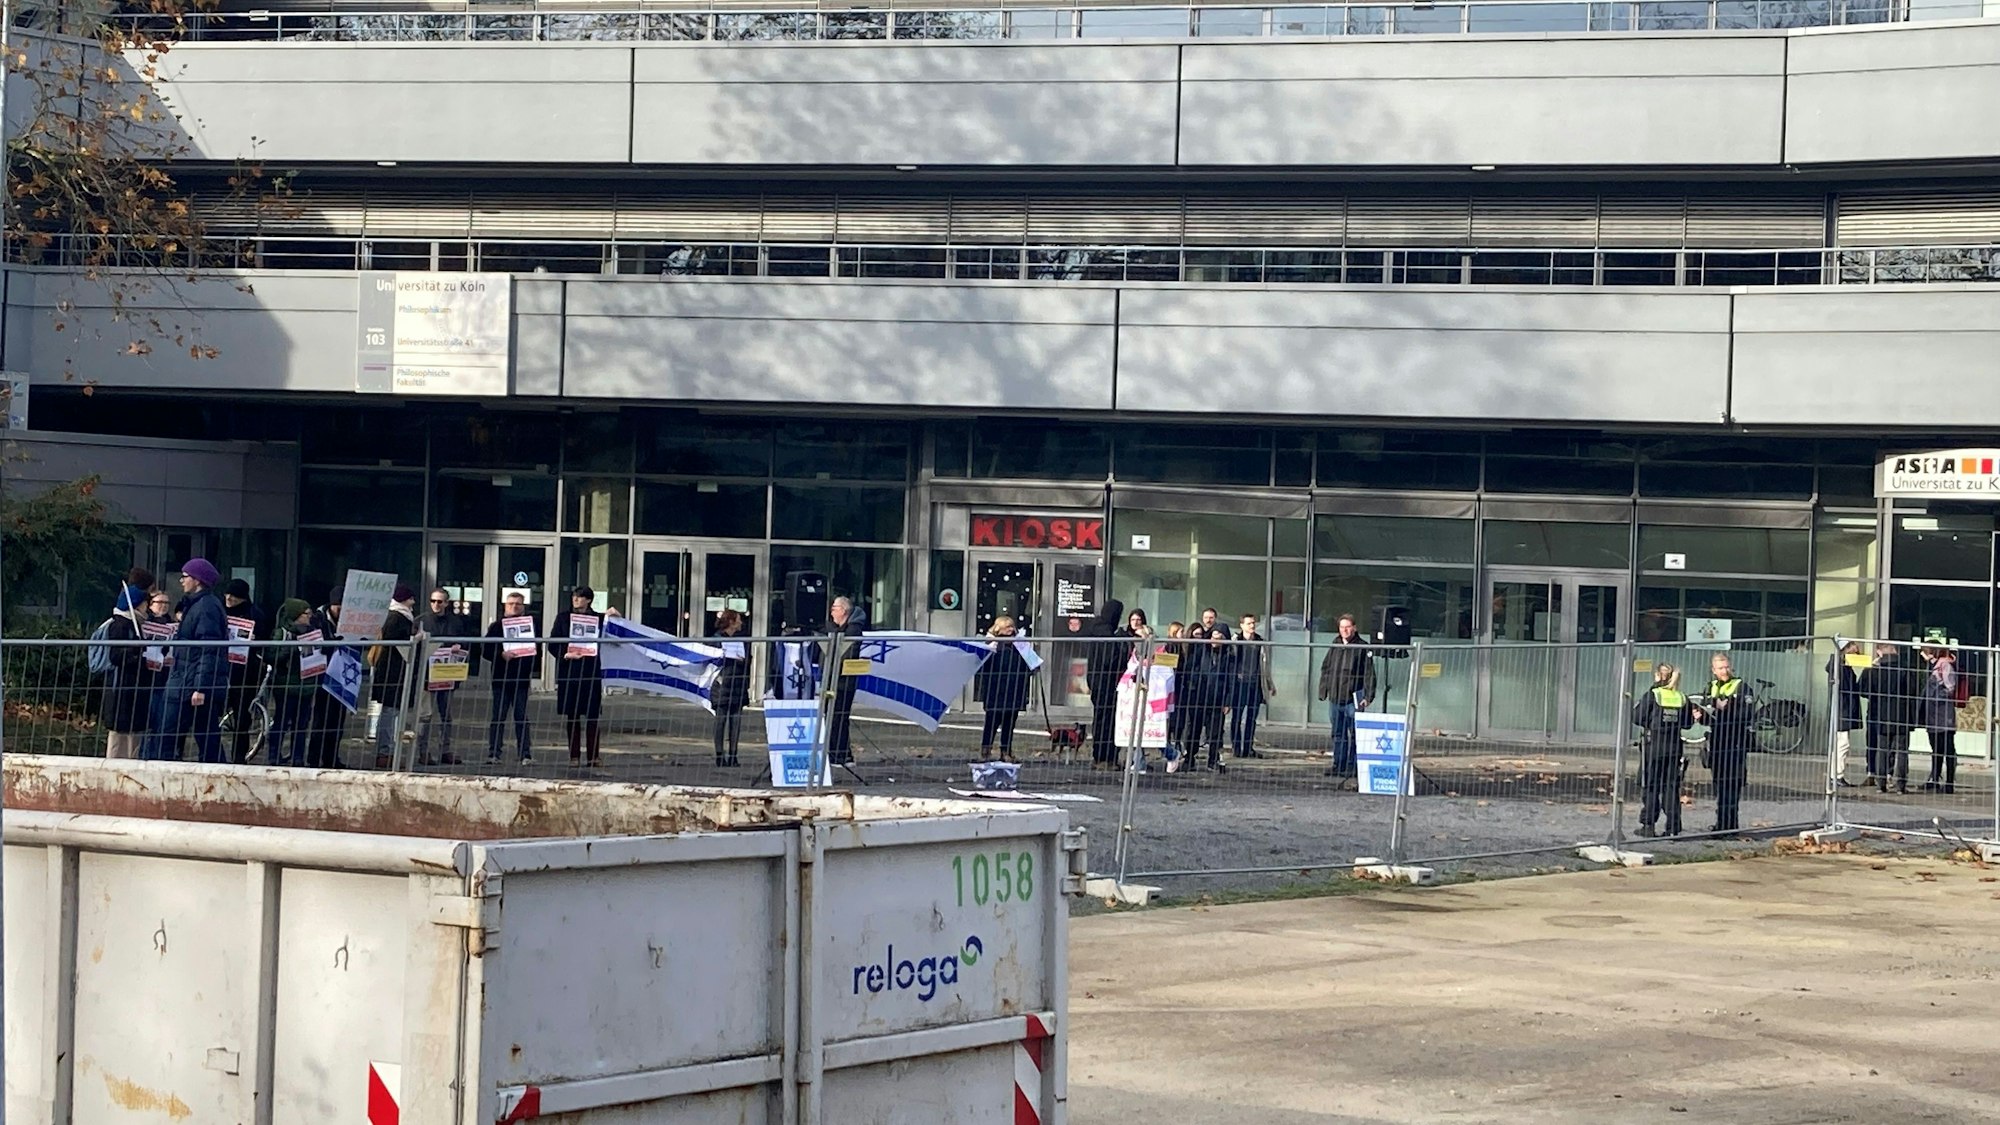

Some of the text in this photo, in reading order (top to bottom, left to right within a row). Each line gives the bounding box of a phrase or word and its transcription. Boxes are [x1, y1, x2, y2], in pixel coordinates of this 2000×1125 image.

[376, 279, 486, 293] Universität zu Köln
[365, 333, 386, 346] 103
[396, 368, 451, 378] Philosophische
[396, 378, 426, 387] Fakultät
[1891, 475, 2000, 490] Universität zu K
[973, 517, 1103, 549] KIOSK
[952, 851, 1033, 907] 1058
[853, 943, 958, 1002] reloga
